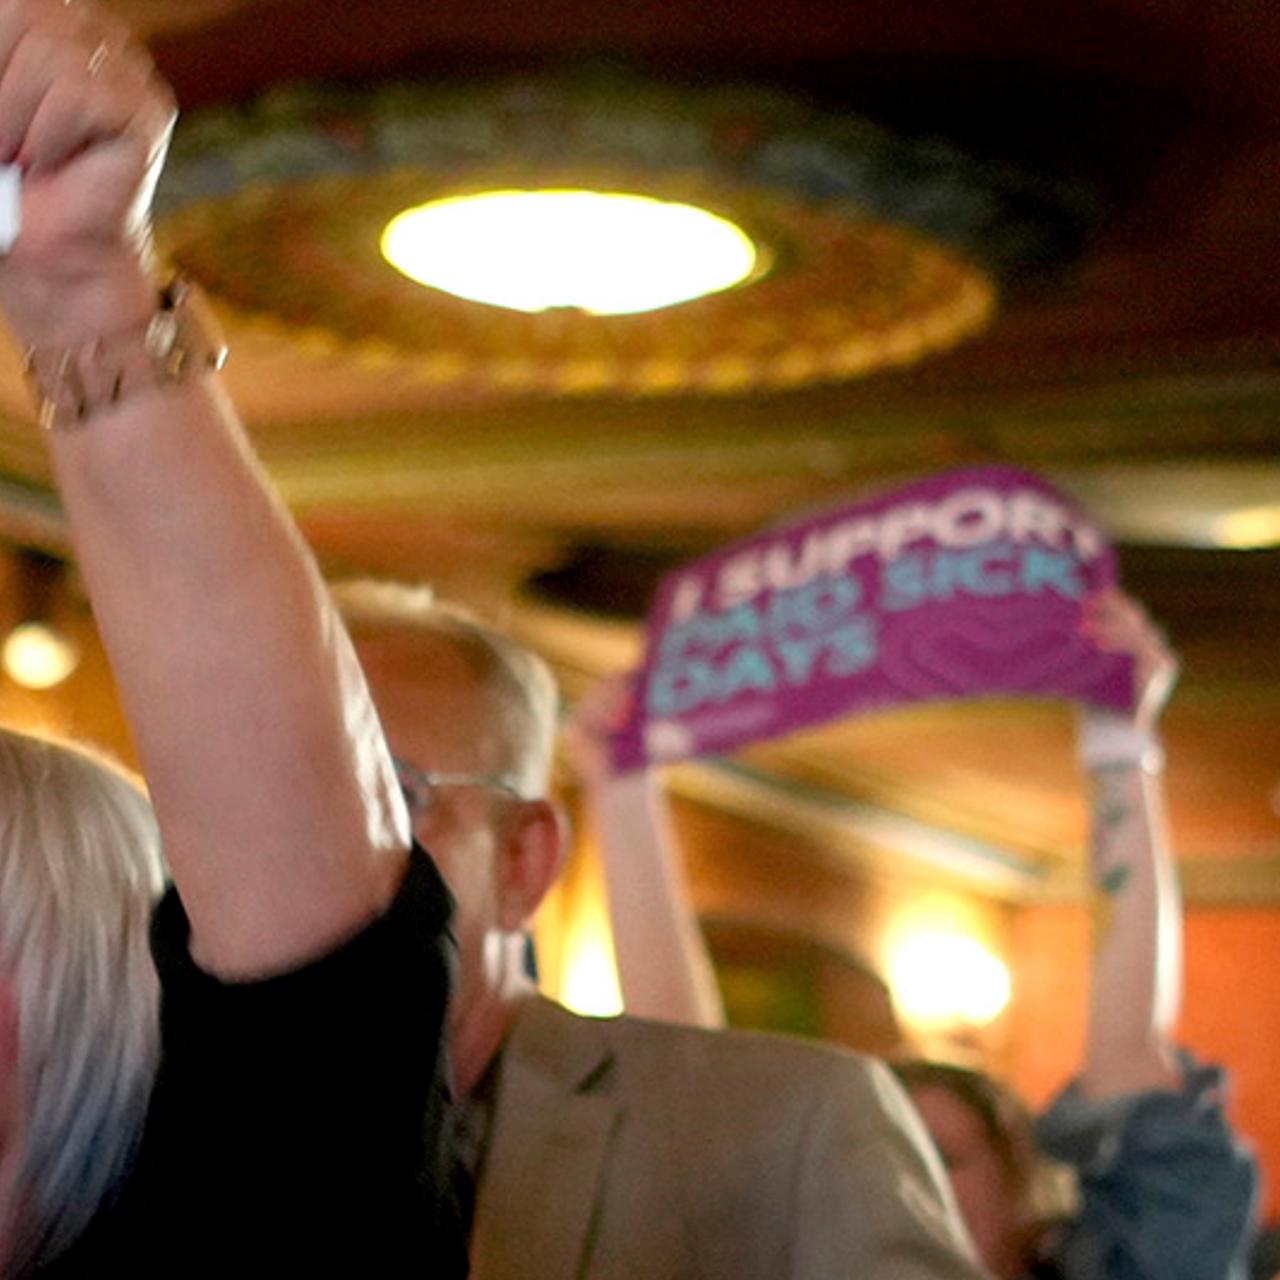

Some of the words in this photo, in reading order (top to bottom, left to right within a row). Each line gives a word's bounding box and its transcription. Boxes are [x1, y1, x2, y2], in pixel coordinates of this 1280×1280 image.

[671, 575, 703, 623] I
[880, 543, 1085, 613] SICK
[648, 615, 878, 715] DAYS
